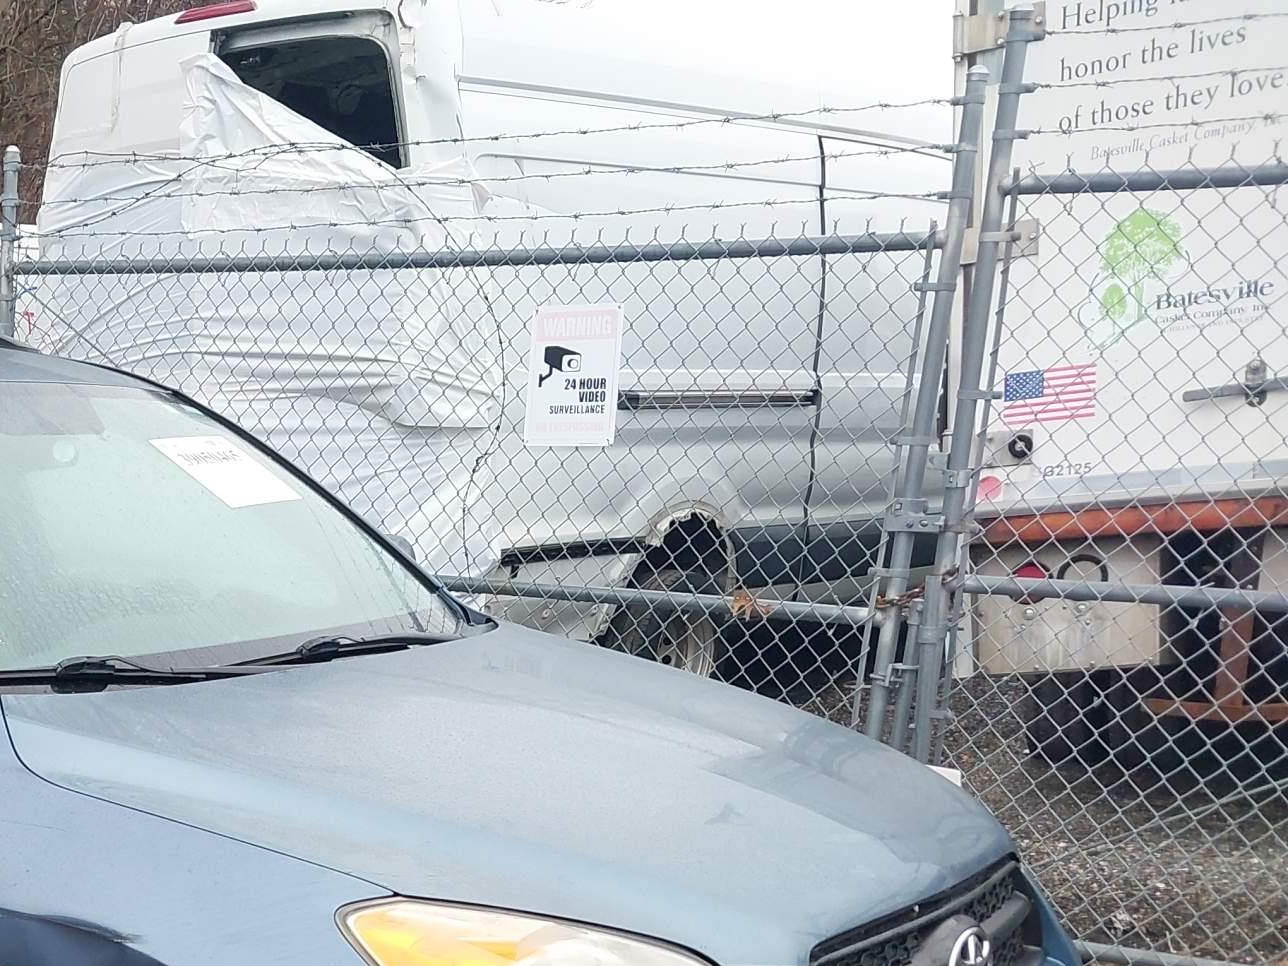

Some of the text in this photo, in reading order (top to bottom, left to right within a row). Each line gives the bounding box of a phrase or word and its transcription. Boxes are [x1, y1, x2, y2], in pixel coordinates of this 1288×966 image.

[1061, 0, 1159, 29] Helping
[1059, 26, 1247, 82] honor the lives
[1059, 108, 1083, 132] of
[1091, 96, 1155, 127] those
[1164, 83, 1220, 111] they
[1156, 279, 1274, 310] Batesville
[543, 315, 612, 337] WARNING
[564, 377, 607, 390] 24 HOUR
[579, 390, 606, 403] VIDEO
[549, 404, 605, 415] SURVEILLANCE
